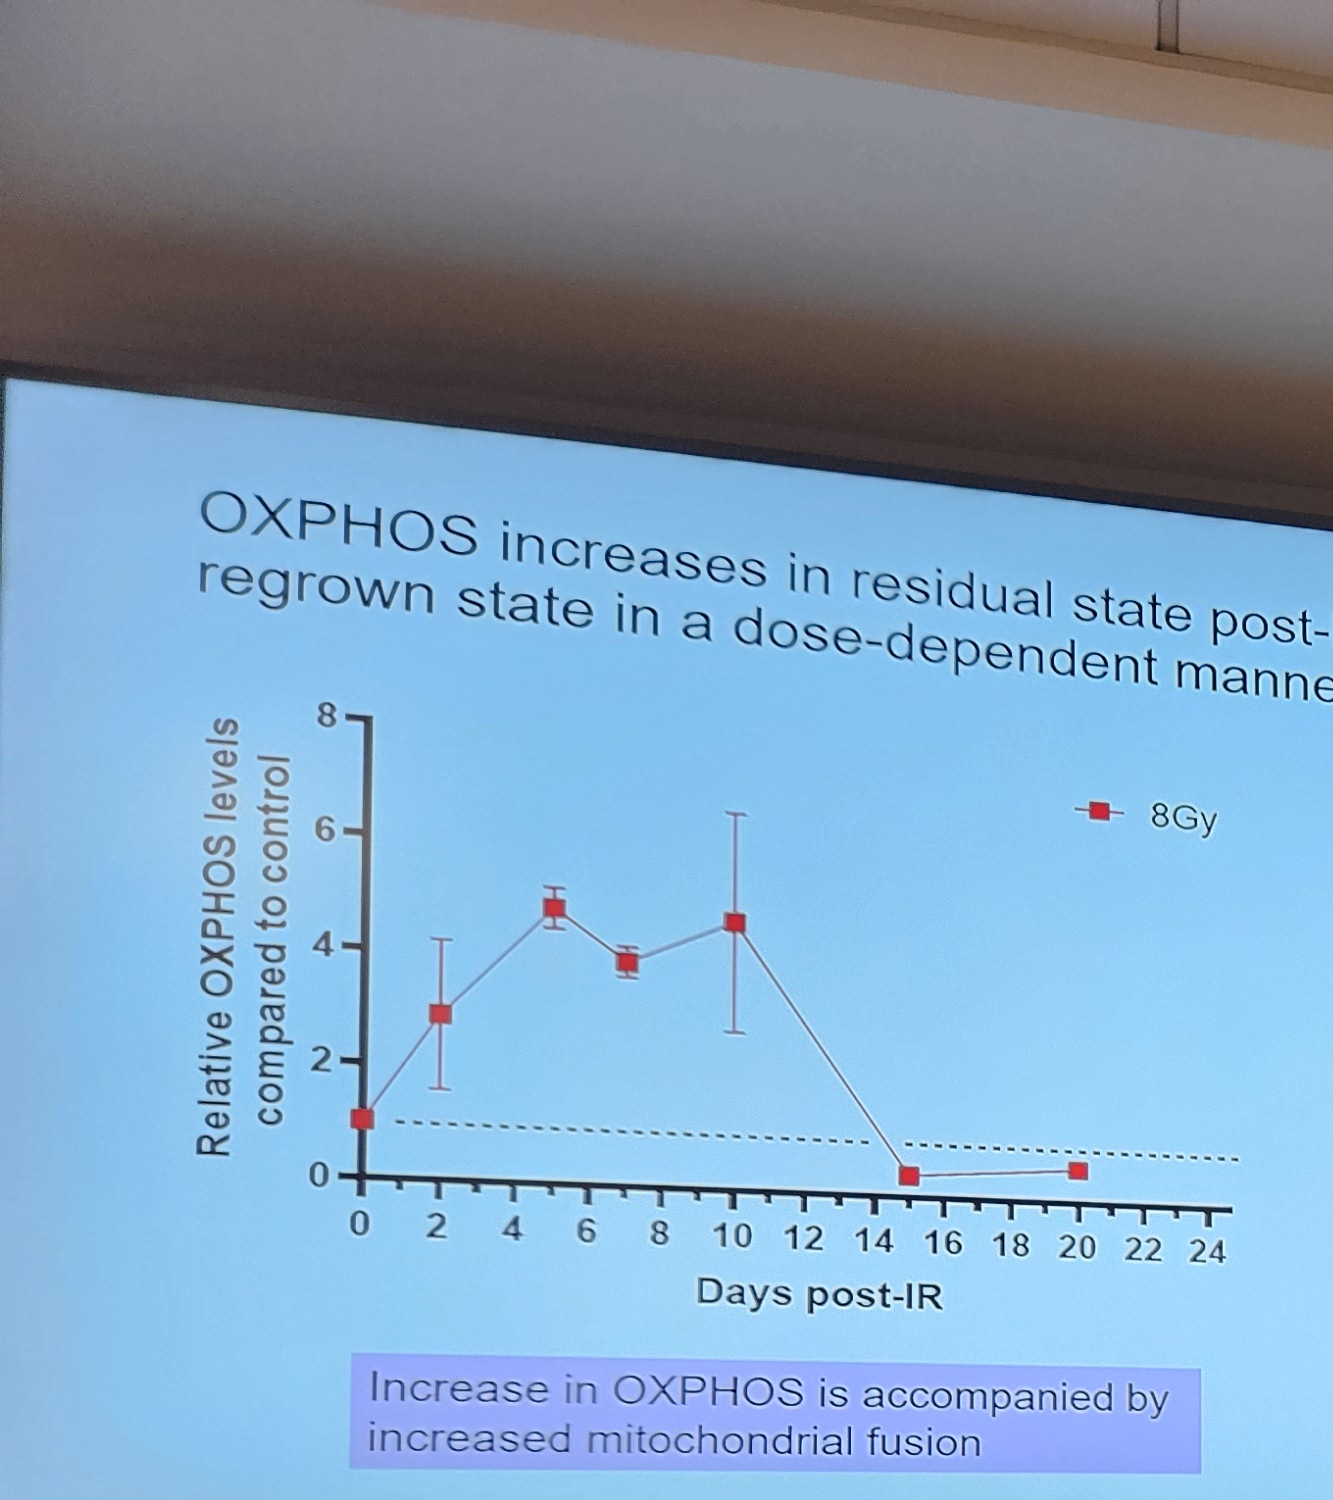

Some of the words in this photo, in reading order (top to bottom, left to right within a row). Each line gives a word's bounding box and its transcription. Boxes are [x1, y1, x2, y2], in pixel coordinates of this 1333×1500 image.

[200, 490, 478, 556] OXPHOS
[502, 520, 768, 589] increases
[789, 551, 830, 596] in
[852, 566, 1053, 622] residual
[1073, 587, 1192, 632] state
[199, 556, 435, 615] regrown
[457, 581, 594, 628] state
[617, 591, 659, 637] in
[682, 611, 712, 642] a
[734, 605, 1164, 686] dose-dependent
[317, 701, 337, 728] 8
[203, 717, 239, 821] levels
[256, 754, 291, 884] control
[315, 815, 336, 843] 6
[1151, 802, 1218, 839] 8Gy
[199, 835, 236, 998] OXPHOS
[253, 895, 287, 931] to
[311, 930, 335, 957] 4
[253, 943, 295, 1126] compared
[310, 1045, 332, 1073] 2
[195, 1011, 233, 1157] Relative
[309, 1161, 330, 1188] 0
[349, 1209, 370, 1236] 0
[426, 1212, 447, 1239] 2
[501, 1215, 523, 1241] 4
[577, 1217, 597, 1243] 6
[650, 1220, 669, 1246] 8
[713, 1222, 753, 1248] 10
[784, 1224, 824, 1251] 12
[855, 1227, 894, 1253] 14
[925, 1229, 963, 1255] 16
[992, 1231, 1030, 1257] 18
[1058, 1234, 1096, 1260] 20
[1124, 1236, 1162, 1262] 22
[1189, 1238, 1227, 1264] 24
[697, 1277, 792, 1313] Days
[807, 1282, 943, 1315] post-IR
[371, 1370, 549, 1404] Increase
[565, 1373, 597, 1405] in
[614, 1375, 804, 1407] OXPHOS
[820, 1377, 849, 1408] is
[863, 1381, 1113, 1418] accompanied
[1128, 1382, 1170, 1420] by
[369, 1420, 570, 1453] increased
[588, 1423, 852, 1456] mitochondrial
[866, 1426, 980, 1457] fusion
